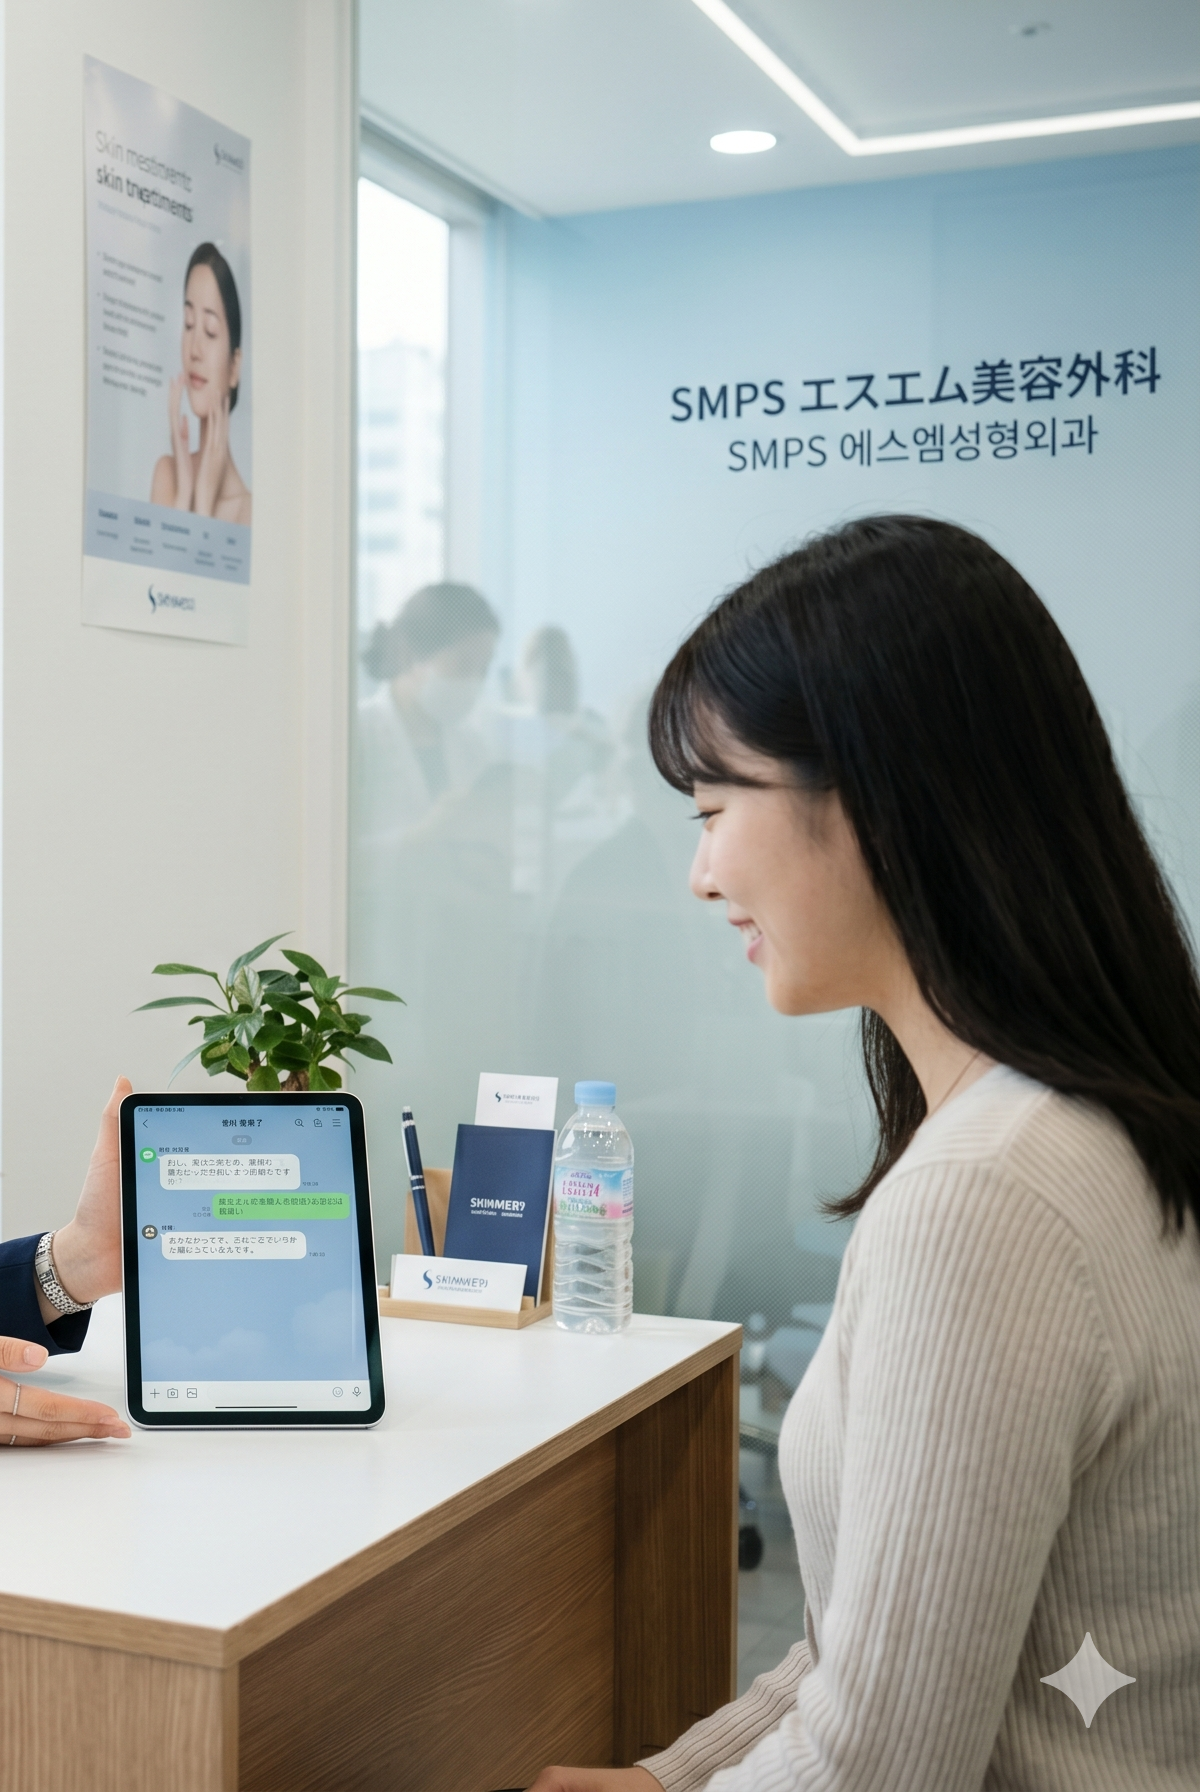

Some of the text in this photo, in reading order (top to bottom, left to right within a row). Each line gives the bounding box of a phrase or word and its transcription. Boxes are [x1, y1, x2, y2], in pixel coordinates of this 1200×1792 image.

[96, 165, 123, 193] skin
[670, 346, 1162, 422] SMPS エスエム美容外科
[727, 414, 1099, 473] SMPS 에스엠성형외과
